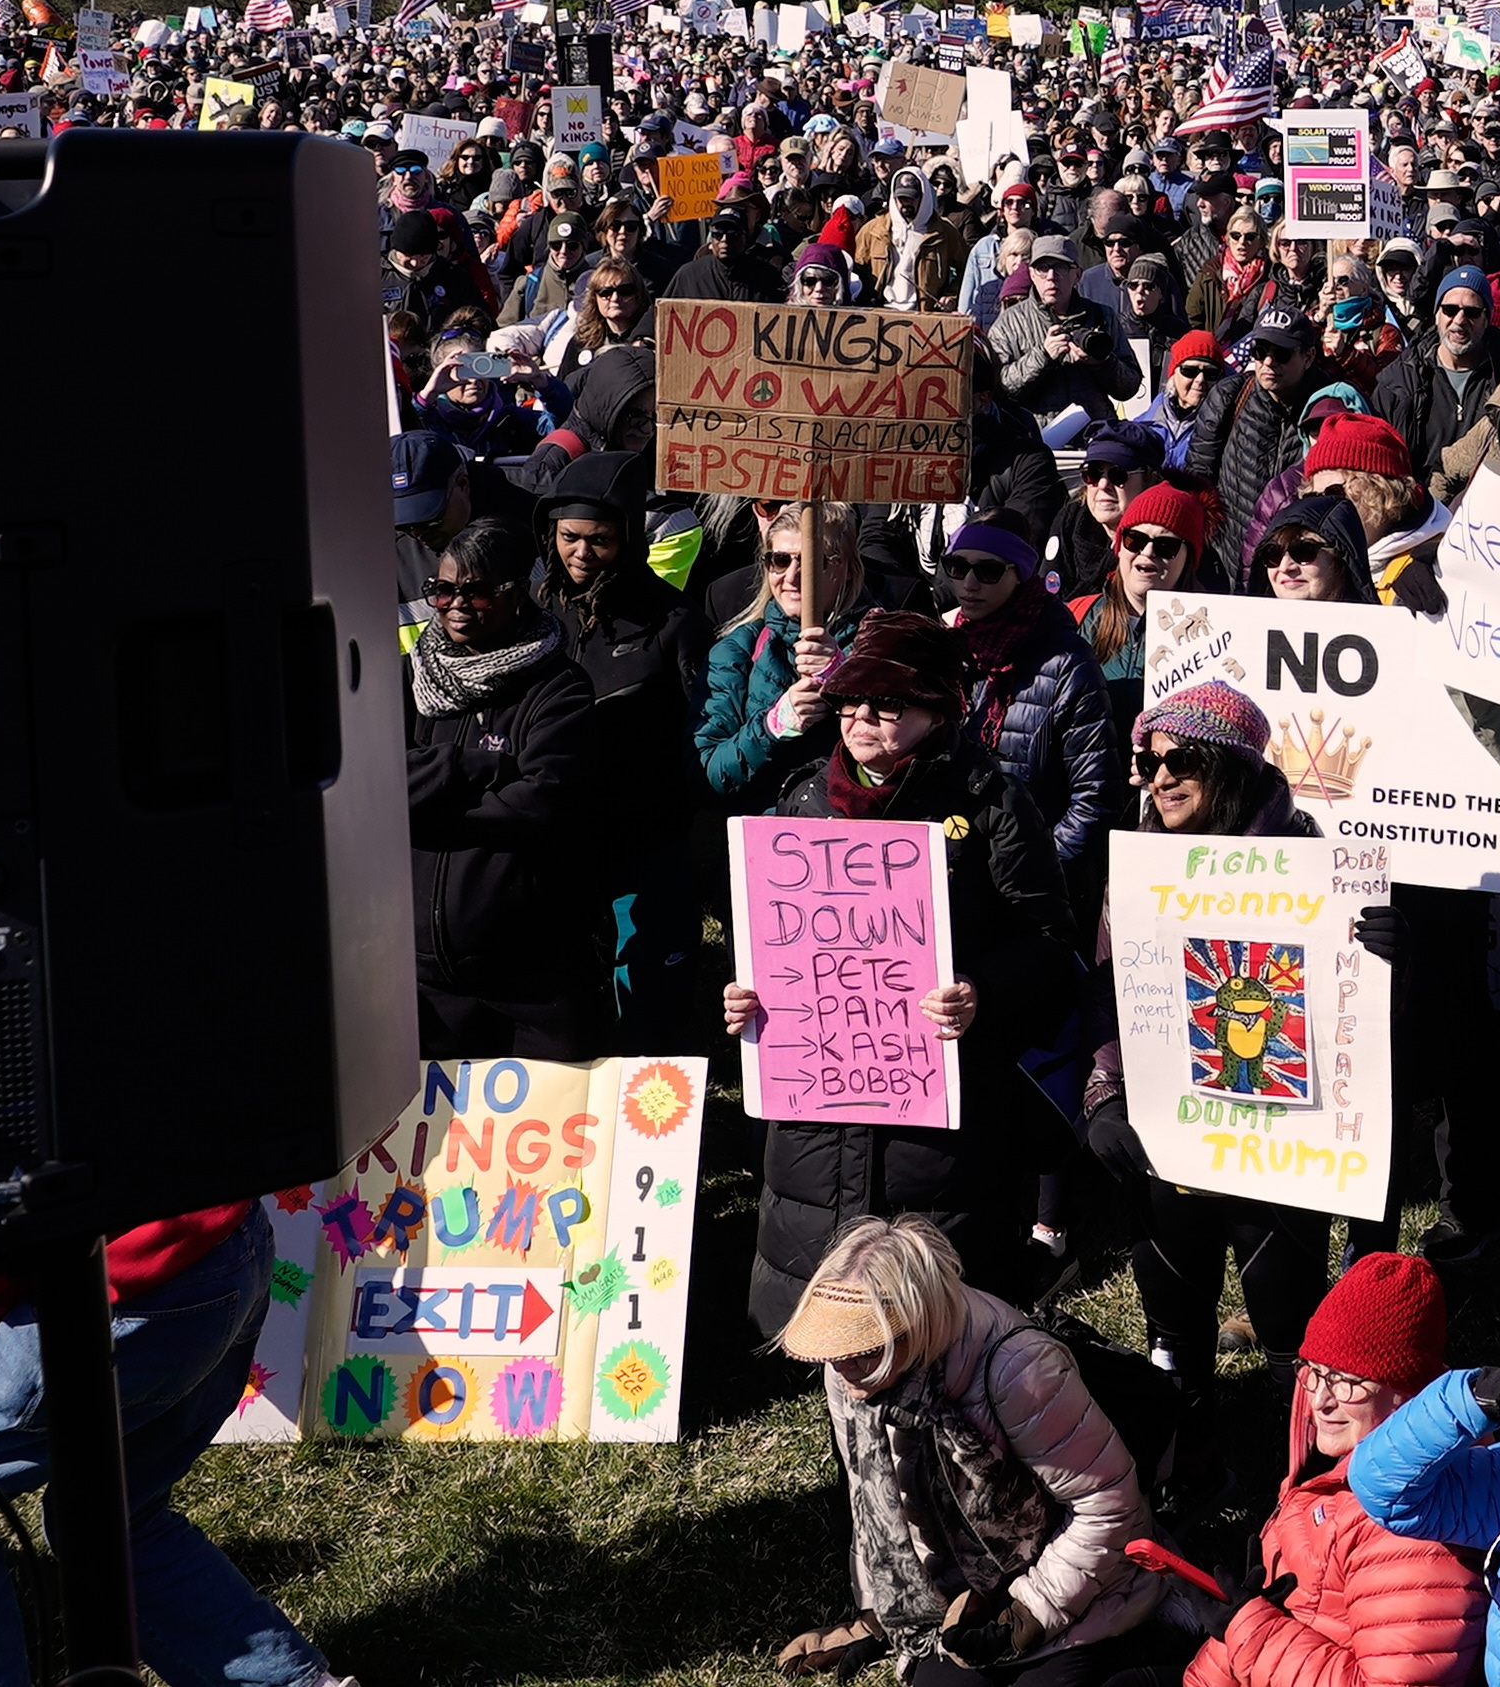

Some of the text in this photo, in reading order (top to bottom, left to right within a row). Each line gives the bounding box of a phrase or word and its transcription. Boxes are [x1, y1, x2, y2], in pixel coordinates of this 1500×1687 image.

[1246, 31, 1270, 44] STOP
[81, 53, 114, 69] Power
[890, 105, 904, 115] NO
[561, 131, 596, 142] KINGS
[569, 121, 585, 131] NO
[1298, 128, 1357, 137] SOLAR POWER
[1329, 157, 1357, 165] PROOF
[1333, 147, 1357, 156] WAR-
[664, 160, 719, 176] NO KINGS
[668, 180, 687, 196] NO
[1309, 183, 1363, 193] WIND POWER
[670, 201, 687, 216] NO
[1334, 213, 1364, 221] PROOF
[1339, 203, 1363, 212] WAR-
[664, 307, 911, 369] NO KINGS
[692, 367, 962, 419] NO WAR
[775, 444, 833, 464] FROM
[666, 442, 965, 502] EPSTEIN FILES
[1152, 630, 1233, 699] WAKE-UP
[1265, 629, 1379, 697] NO
[1372, 786, 1454, 812] DEFEND
[1338, 819, 1498, 850] CONSTITUTION
[768, 831, 921, 891] STEP
[1149, 884, 1326, 925] Tyranny
[764, 898, 926, 948] DOWN
[1119, 940, 1174, 969] 25th
[812, 953, 915, 995] PETE
[817, 995, 910, 1033] PAM
[818, 1032, 930, 1066] KASH
[423, 1059, 531, 1116] NO
[821, 1067, 938, 1097] BOBBY
[1177, 1094, 1288, 1134] DUMP
[356, 1113, 599, 1176] KINGS
[321, 1186, 592, 1258] TRUMP
[356, 1279, 527, 1341] EXIT
[615, 1368, 643, 1396] ICE
[626, 1362, 647, 1383] NO
[333, 1364, 555, 1427] NOW
